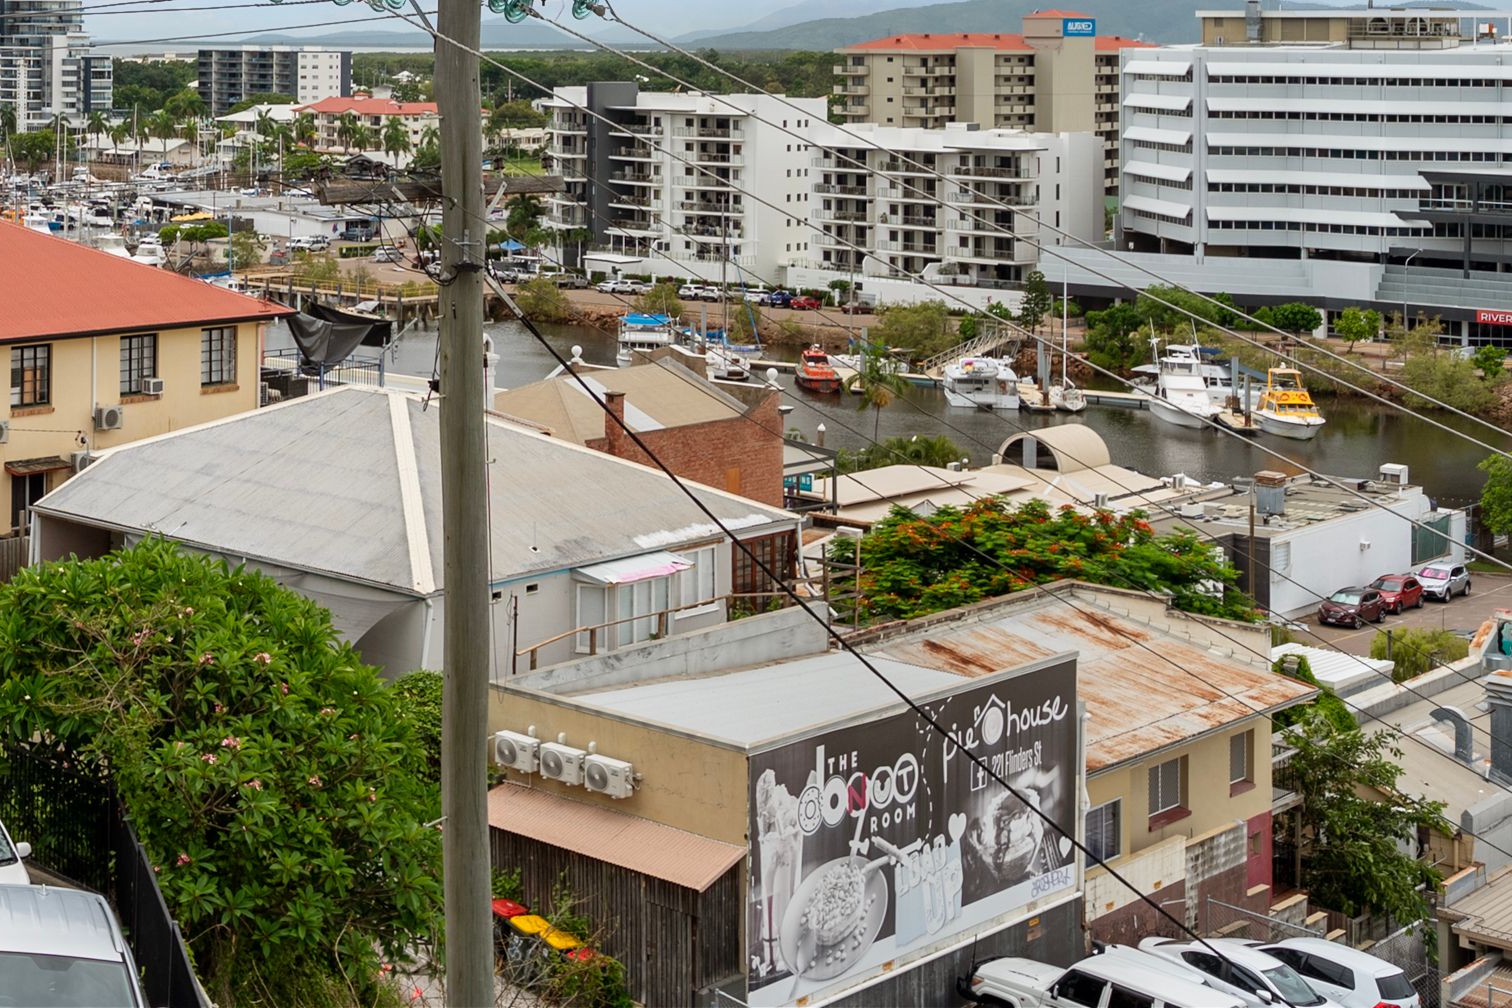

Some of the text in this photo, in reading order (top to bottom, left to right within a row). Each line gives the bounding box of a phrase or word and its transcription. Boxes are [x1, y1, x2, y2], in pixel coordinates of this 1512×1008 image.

[943, 695, 1069, 784] pie house
[827, 750, 858, 775] THE
[1005, 746, 1033, 776] Flinders
[1033, 740, 1043, 766] St
[870, 802, 916, 833] ROOM
